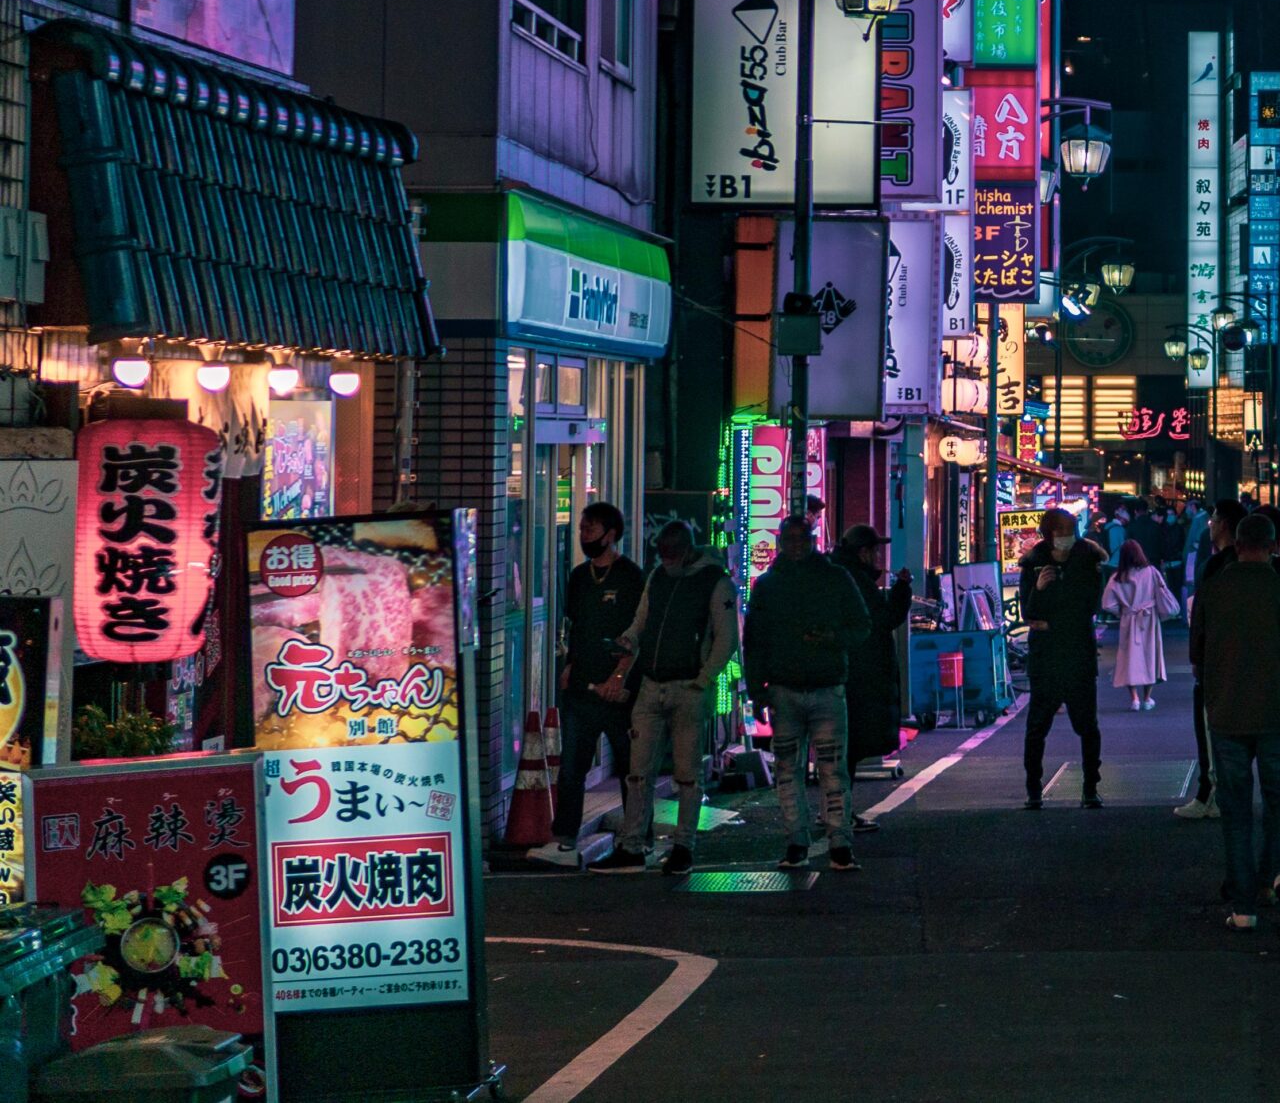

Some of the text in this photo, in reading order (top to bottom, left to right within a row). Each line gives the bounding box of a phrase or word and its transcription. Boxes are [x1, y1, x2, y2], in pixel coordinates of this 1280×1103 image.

[995, 93, 1029, 161] 八方
[1197, 119, 1210, 150] 焼肉
[719, 174, 753, 198] B1
[945, 189, 966, 205] 1F
[974, 189, 1011, 203] hisha
[974, 202, 1034, 216] lchemist
[1196, 179, 1212, 237] 叙々苑
[950, 317, 966, 331] B1
[905, 387, 922, 401] B1
[97, 444, 179, 642] 炭火焼き
[265, 543, 317, 570] お得
[266, 639, 444, 716] 元ちゃん
[330, 760, 446, 788] 韓国本場の炭火焼肉
[208, 863, 248, 892] 3F
[281, 848, 446, 914] 炭火焼肉
[272, 937, 461, 975] 03)6380-2383
